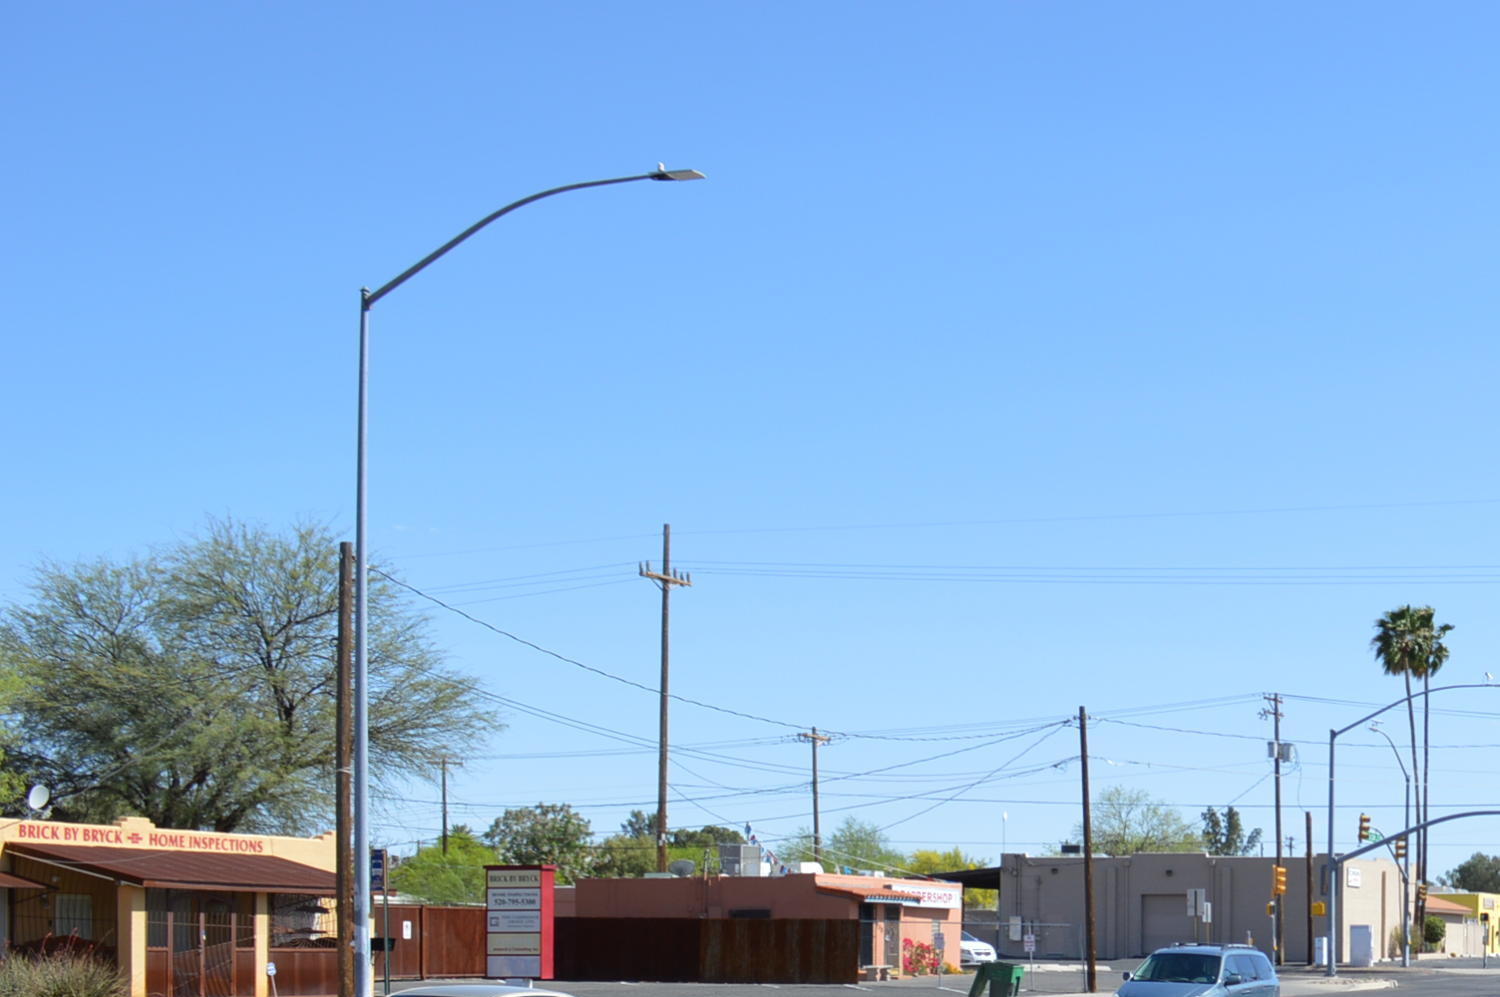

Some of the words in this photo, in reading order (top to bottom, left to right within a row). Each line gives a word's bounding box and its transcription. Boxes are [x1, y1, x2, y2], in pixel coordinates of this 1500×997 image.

[19, 824, 59, 840] BRICK
[64, 827, 79, 841] BY
[83, 829, 122, 843] BRYCK
[149, 833, 185, 848] HOME
[189, 836, 263, 853] INSPECTIONS
